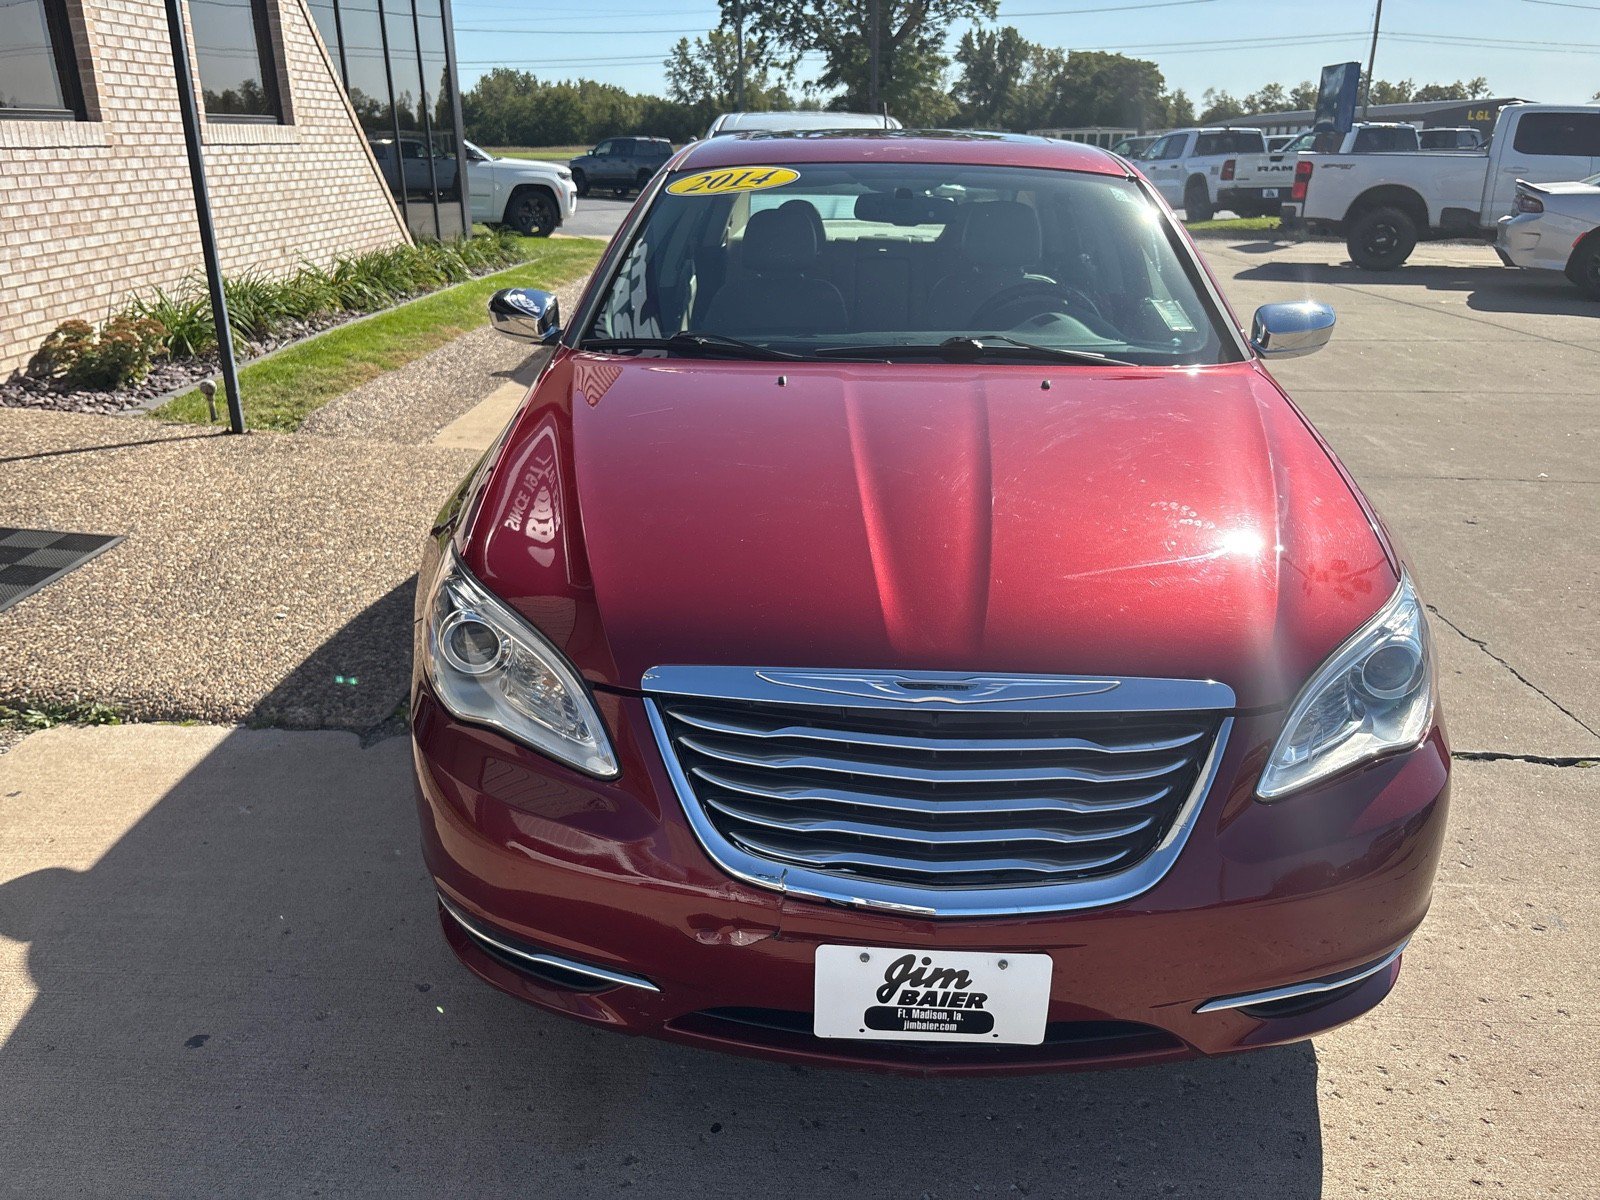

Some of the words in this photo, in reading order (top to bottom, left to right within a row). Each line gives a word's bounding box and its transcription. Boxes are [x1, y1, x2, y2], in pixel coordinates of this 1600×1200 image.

[682, 170, 779, 192] 2014
[876, 953, 973, 1004] Jim
[896, 989, 988, 1009] BAIER
[897, 1008, 908, 1019] Ft.
[911, 1009, 950, 1022] Madison,
[903, 1020, 957, 1032] jimbaier.com
